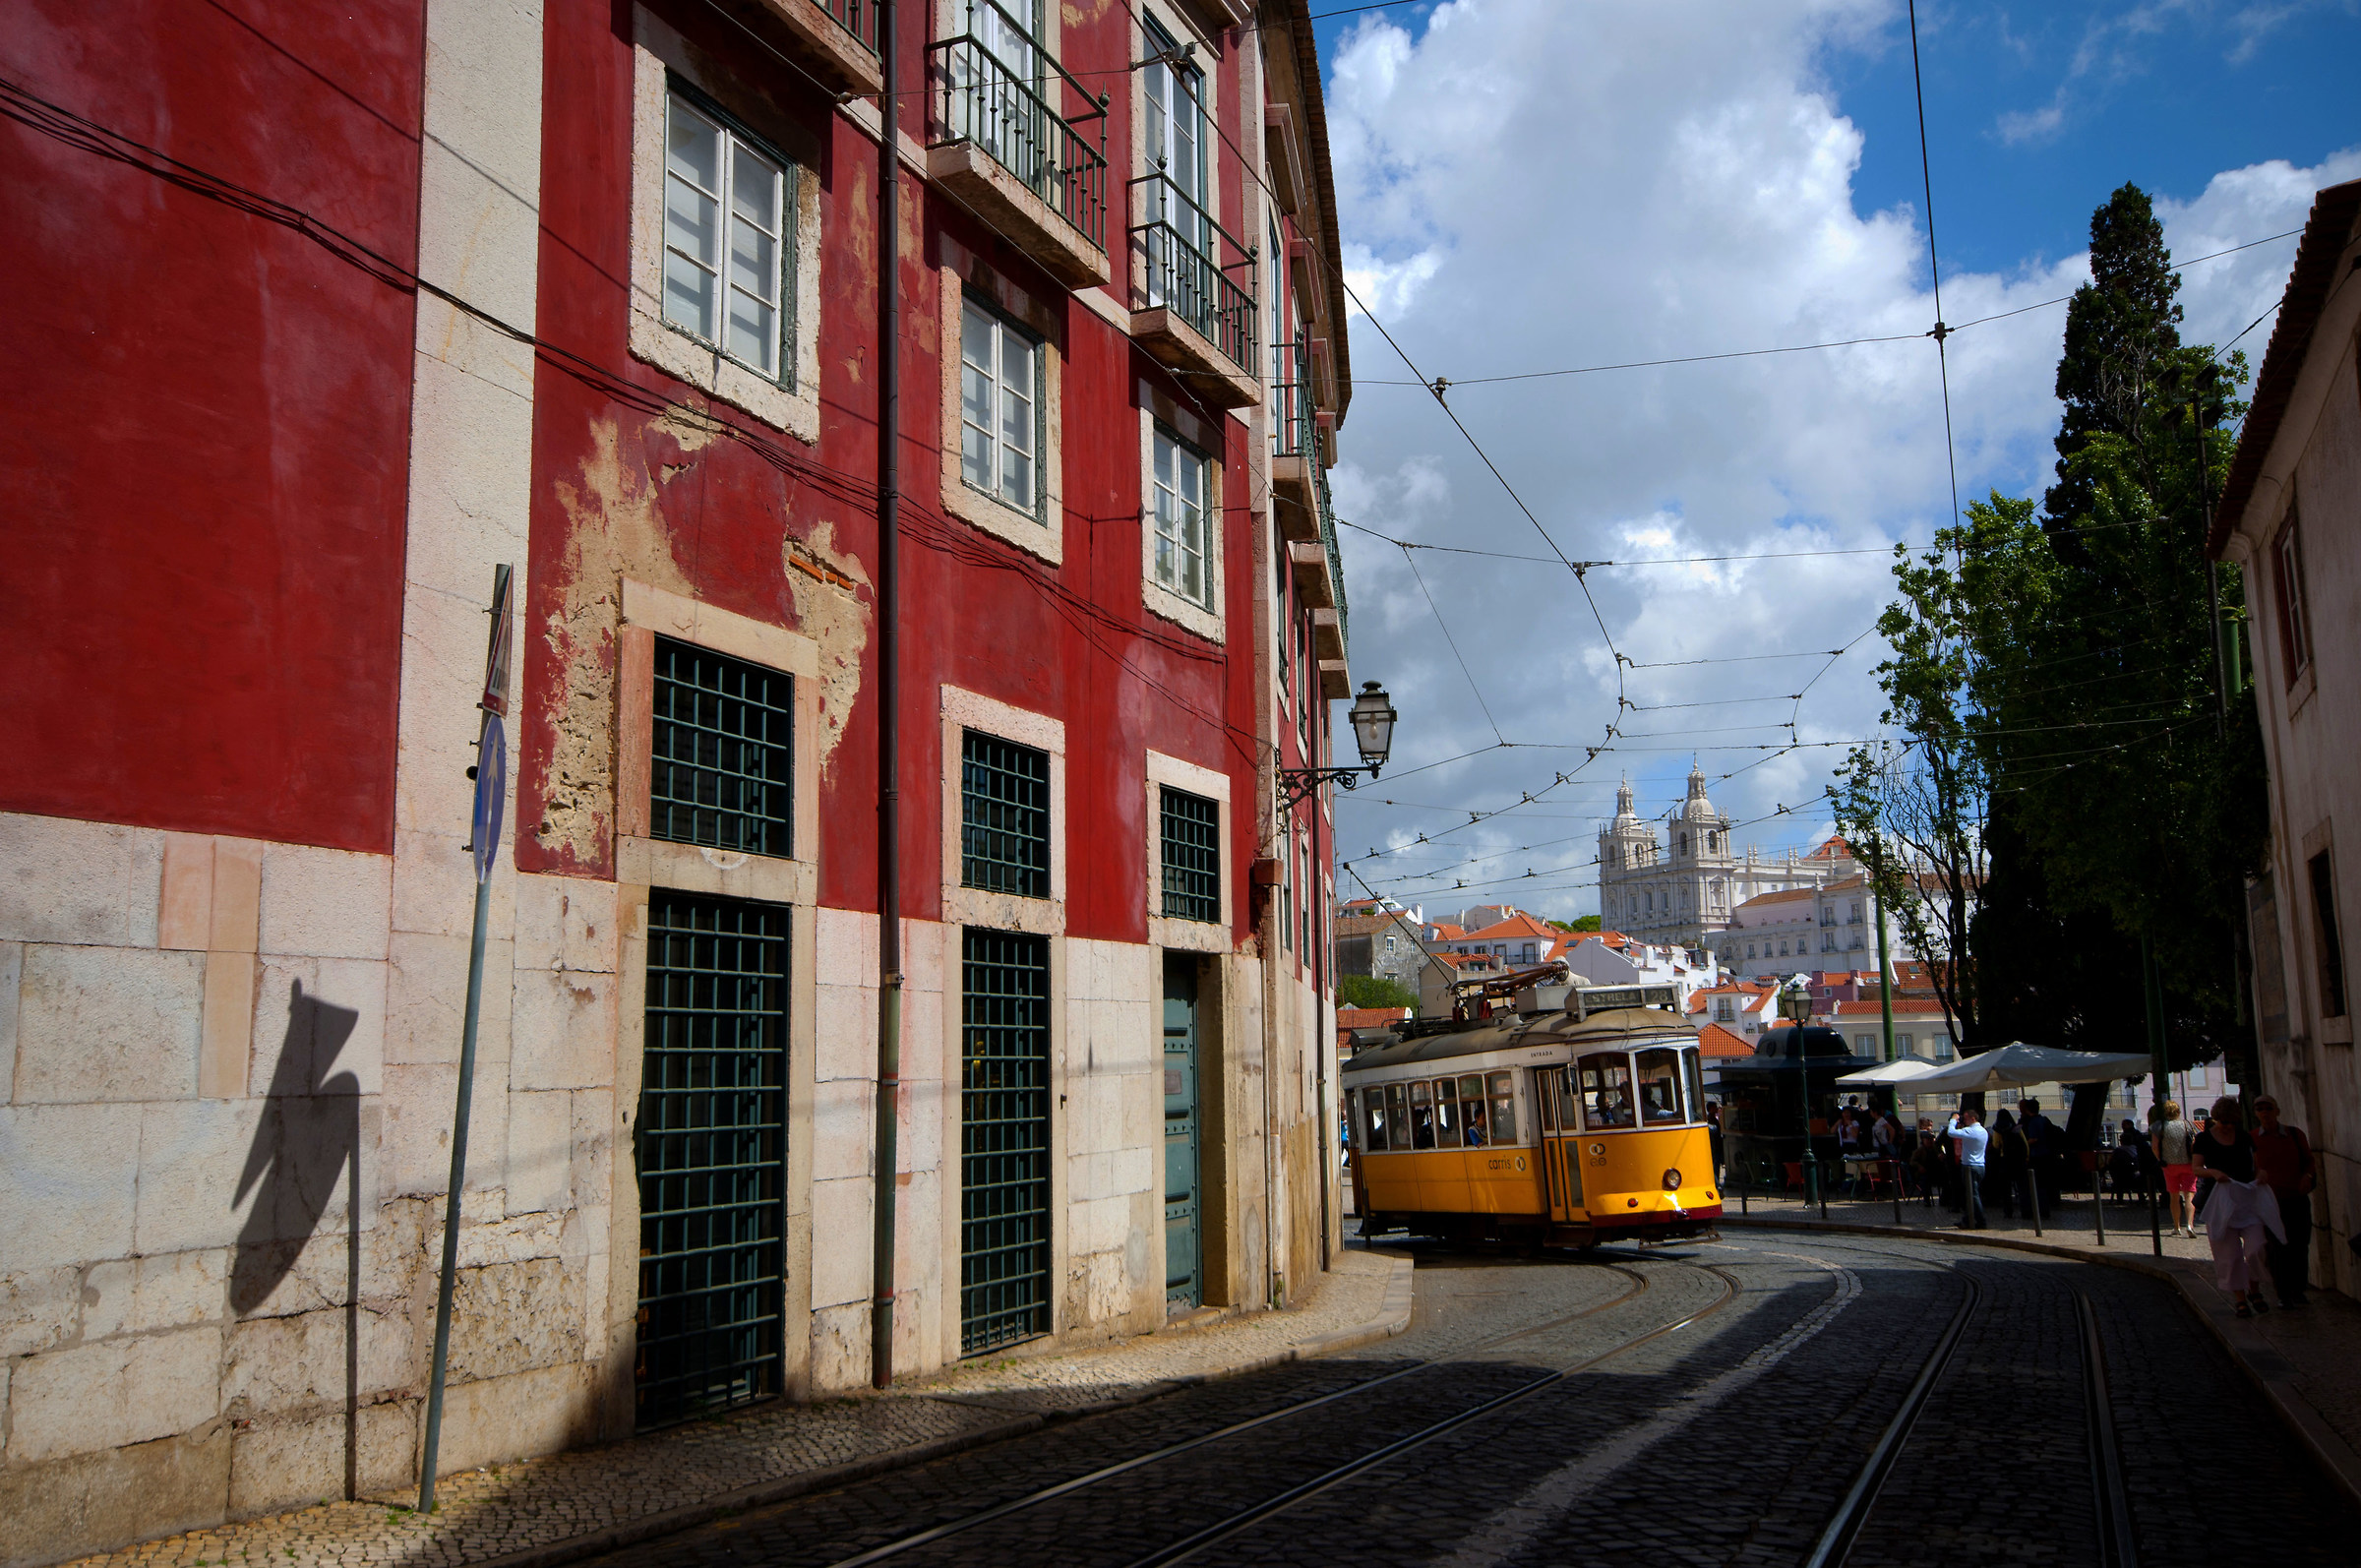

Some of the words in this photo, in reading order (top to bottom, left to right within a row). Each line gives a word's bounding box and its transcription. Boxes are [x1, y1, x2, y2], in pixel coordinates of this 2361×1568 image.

[1585, 992, 1636, 1003] ESTRELA
[1650, 990, 1668, 1001] 28
[1487, 1155, 1512, 1171] carris
